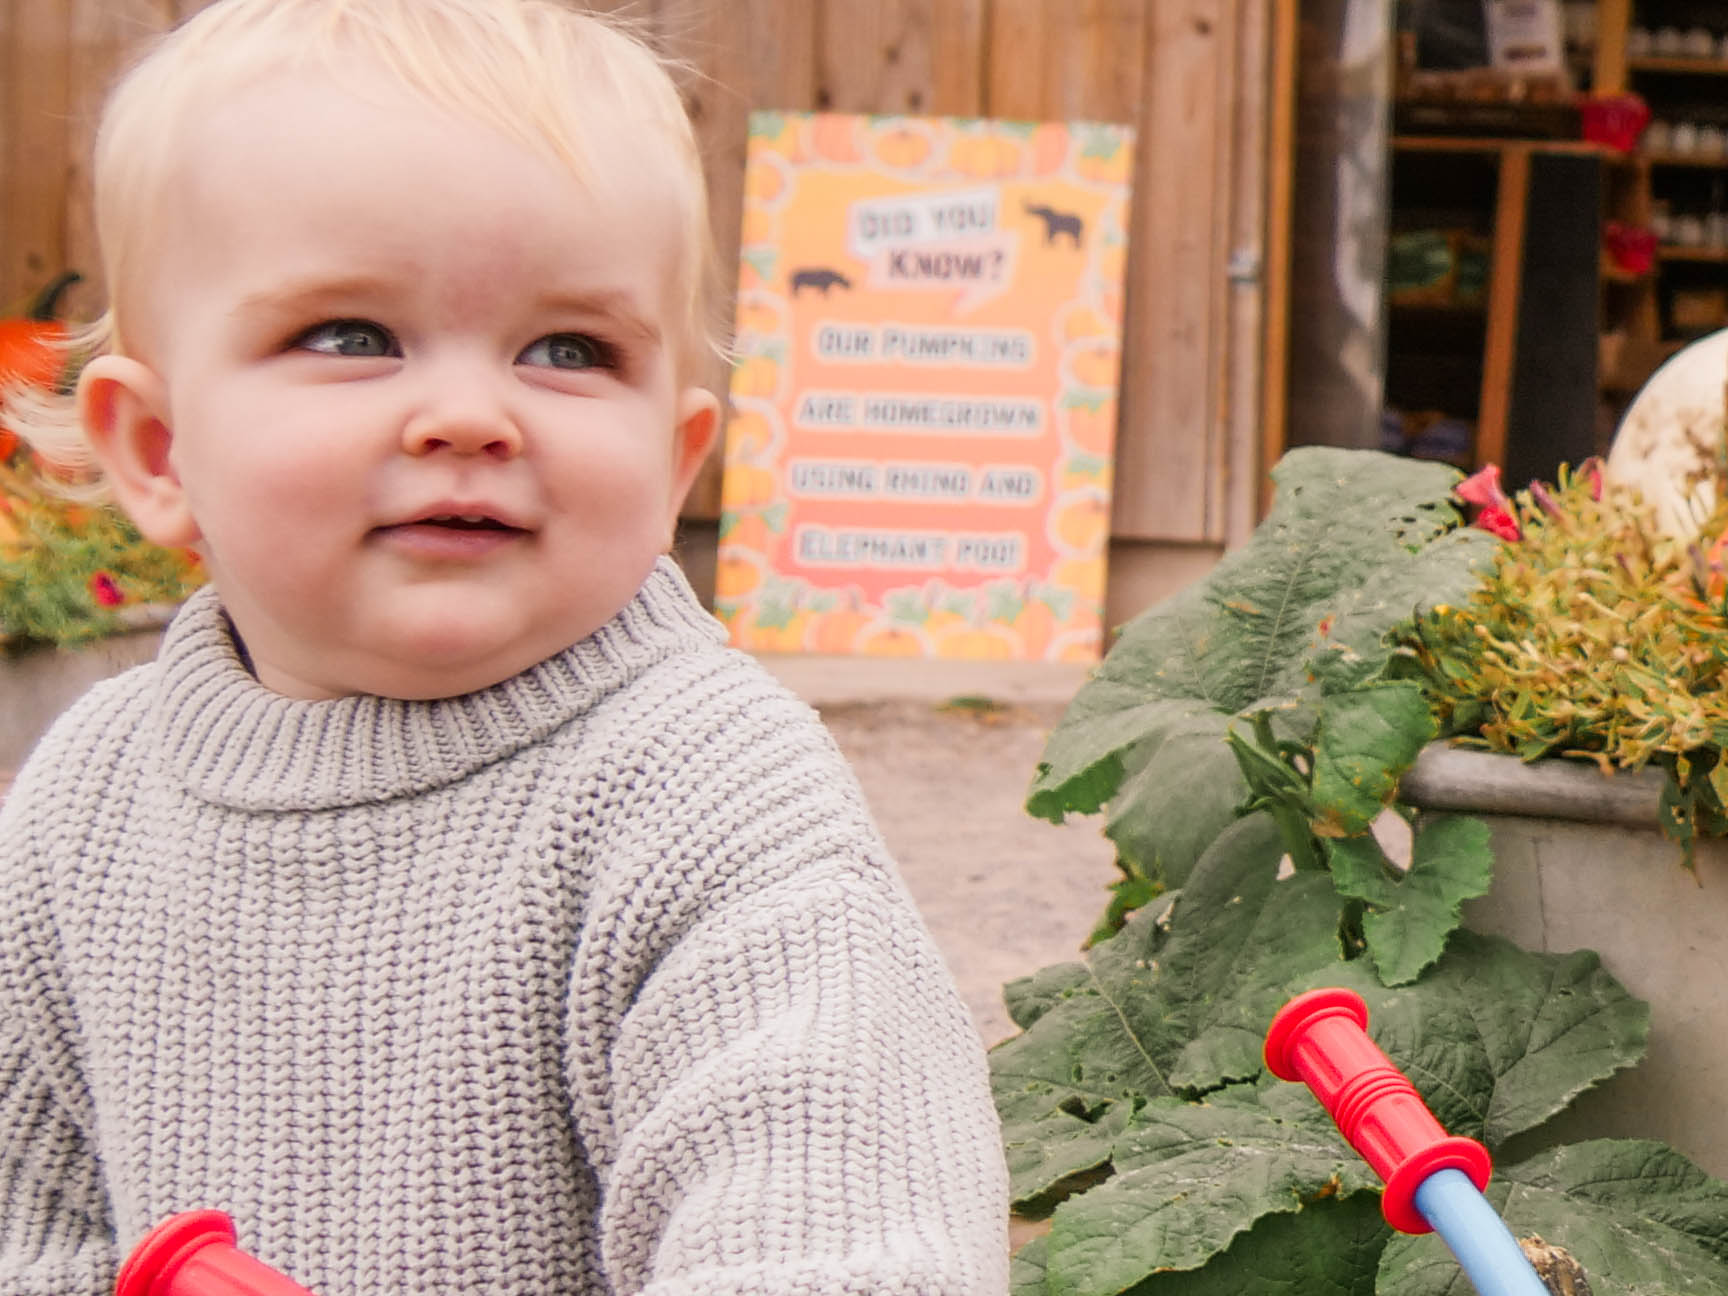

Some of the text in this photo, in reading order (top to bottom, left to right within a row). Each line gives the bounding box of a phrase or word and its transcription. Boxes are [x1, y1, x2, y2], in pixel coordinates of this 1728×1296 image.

[861, 204, 993, 240] DID YOU
[888, 251, 1004, 280] KNOW?
[818, 326, 1028, 360] OUR PUMPKINS
[800, 397, 1038, 427] ARE HOMEGROWN
[792, 464, 1034, 496] USING RHINO AND
[802, 530, 947, 563] ELEPHANT
